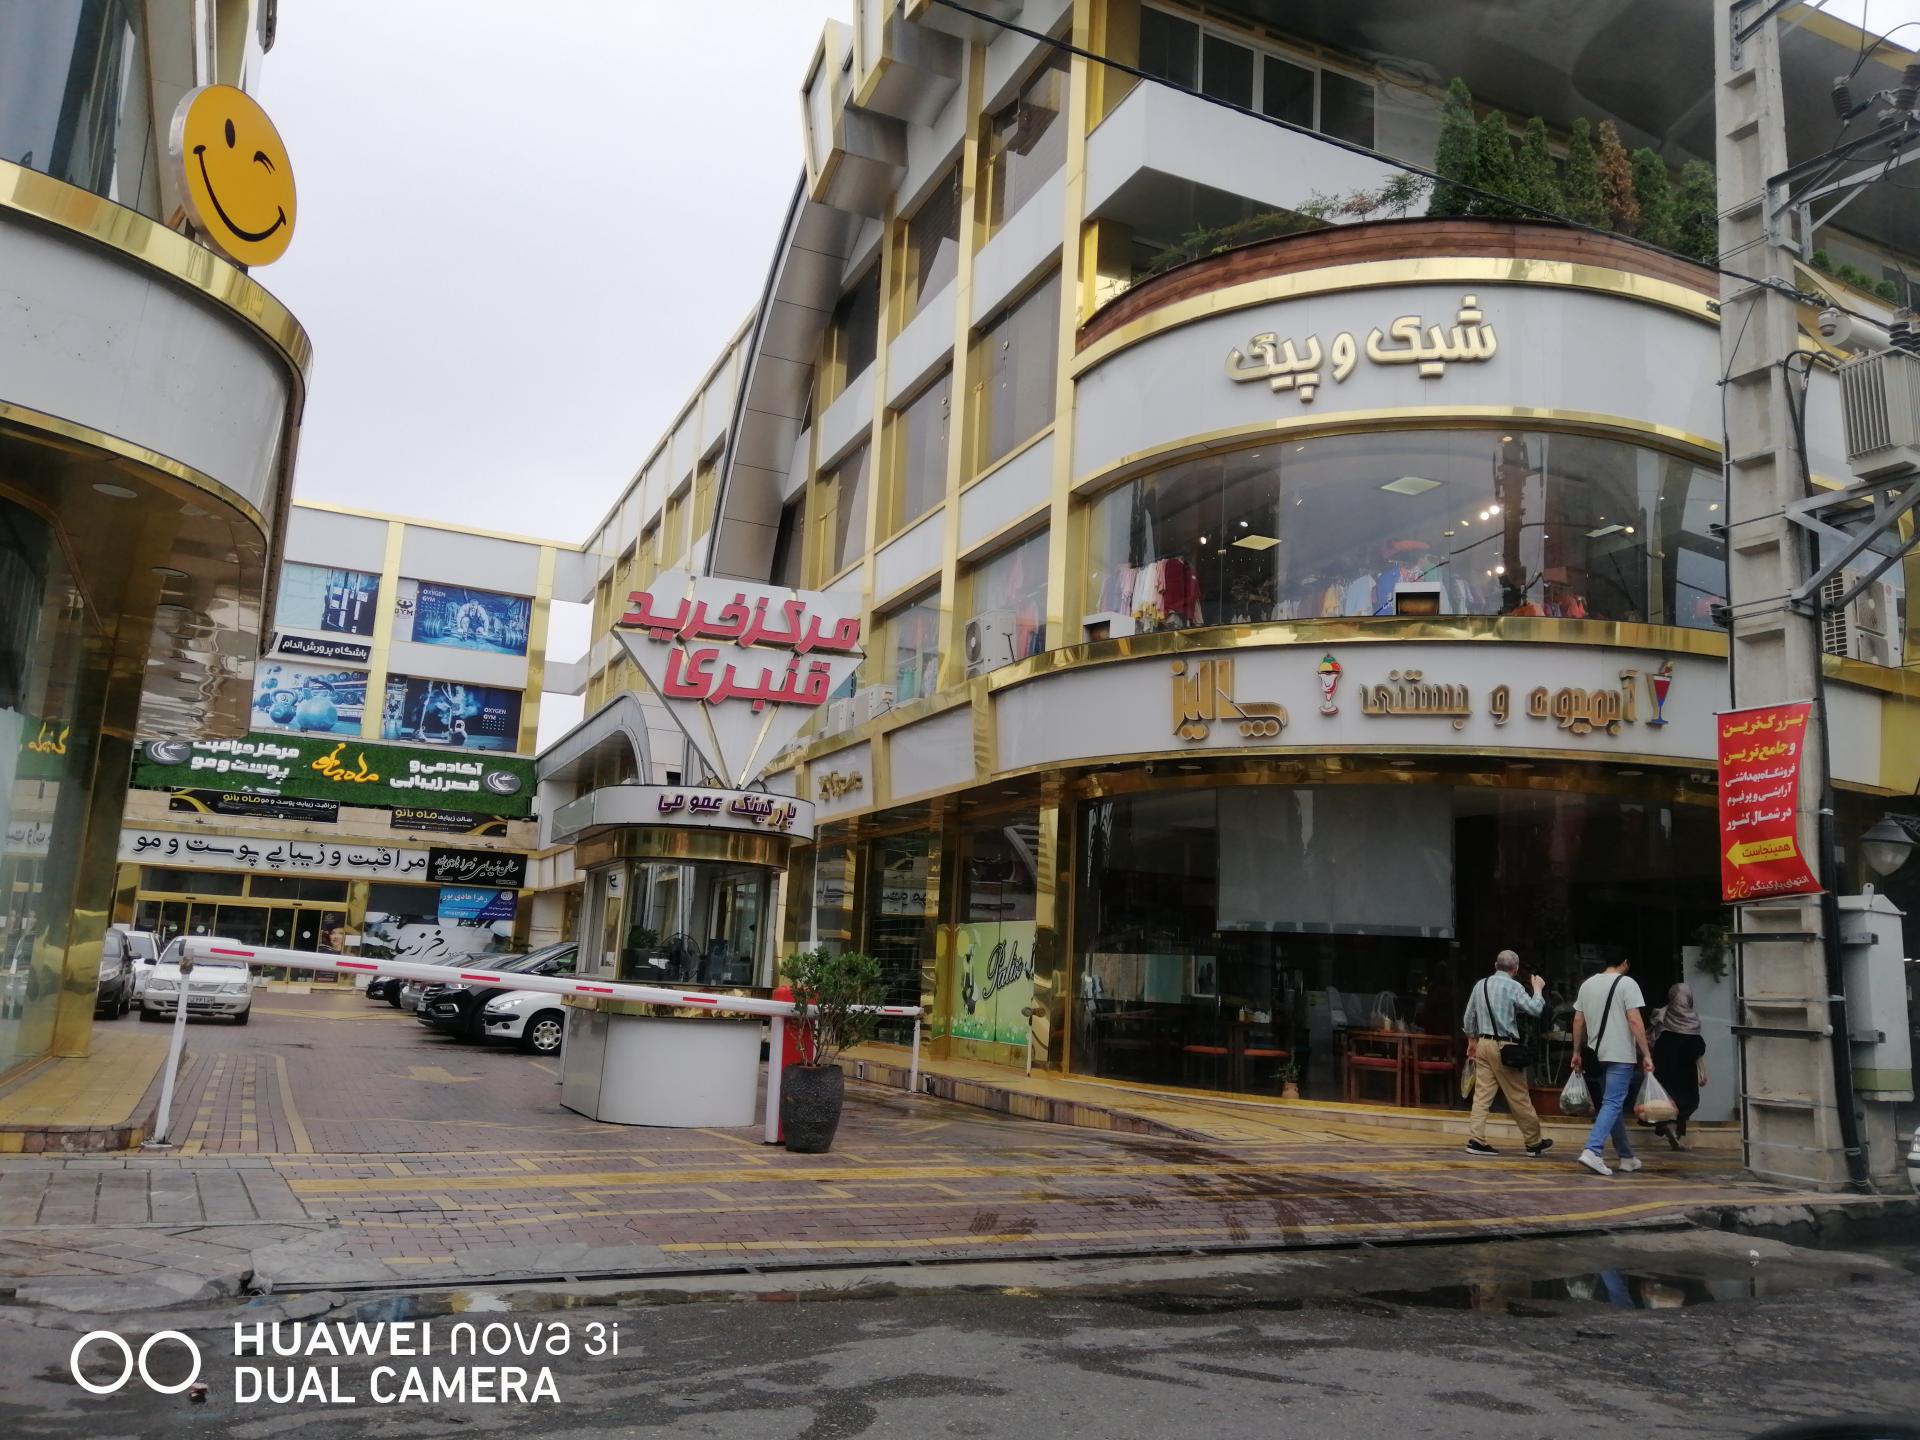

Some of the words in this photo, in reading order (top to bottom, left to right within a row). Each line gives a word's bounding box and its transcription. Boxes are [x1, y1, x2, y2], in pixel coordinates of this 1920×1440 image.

[1365, 294, 1497, 379] شیک
[1331, 331, 1358, 384] و
[618, 590, 751, 643] خرید
[738, 596, 861, 654] مرکز
[282, 640, 303, 650] اندام
[302, 641, 334, 657] پرورش
[335, 645, 368, 660] باشگاه
[663, 647, 832, 714] قنبری
[1360, 669, 1473, 731] بستنی
[1488, 684, 1510, 728] و
[1526, 668, 1638, 738] آبمیوه
[483, 707, 507, 716] OXYGEN
[253, 742, 300, 759] مرکز
[190, 755, 215, 771] مو
[216, 758, 231, 773] و
[231, 759, 290, 784] پوست
[420, 761, 484, 776] آکادمی
[389, 774, 443, 793] زیبایی
[222, 792, 241, 802] بانو
[241, 794, 261, 804] ماه
[658, 793, 723, 816] عمومی
[394, 809, 415, 820] بانو
[416, 810, 438, 819] ماه
[728, 794, 797, 829] پارکینگ
[1751, 807, 1781, 826] شمال
[1780, 807, 1793, 822] در
[1725, 811, 1750, 832] کشور
[132, 835, 162, 853] مو
[165, 837, 180, 855] و
[186, 839, 259, 867] پوست
[329, 848, 342, 867] و
[347, 846, 427, 873] مراقبت
